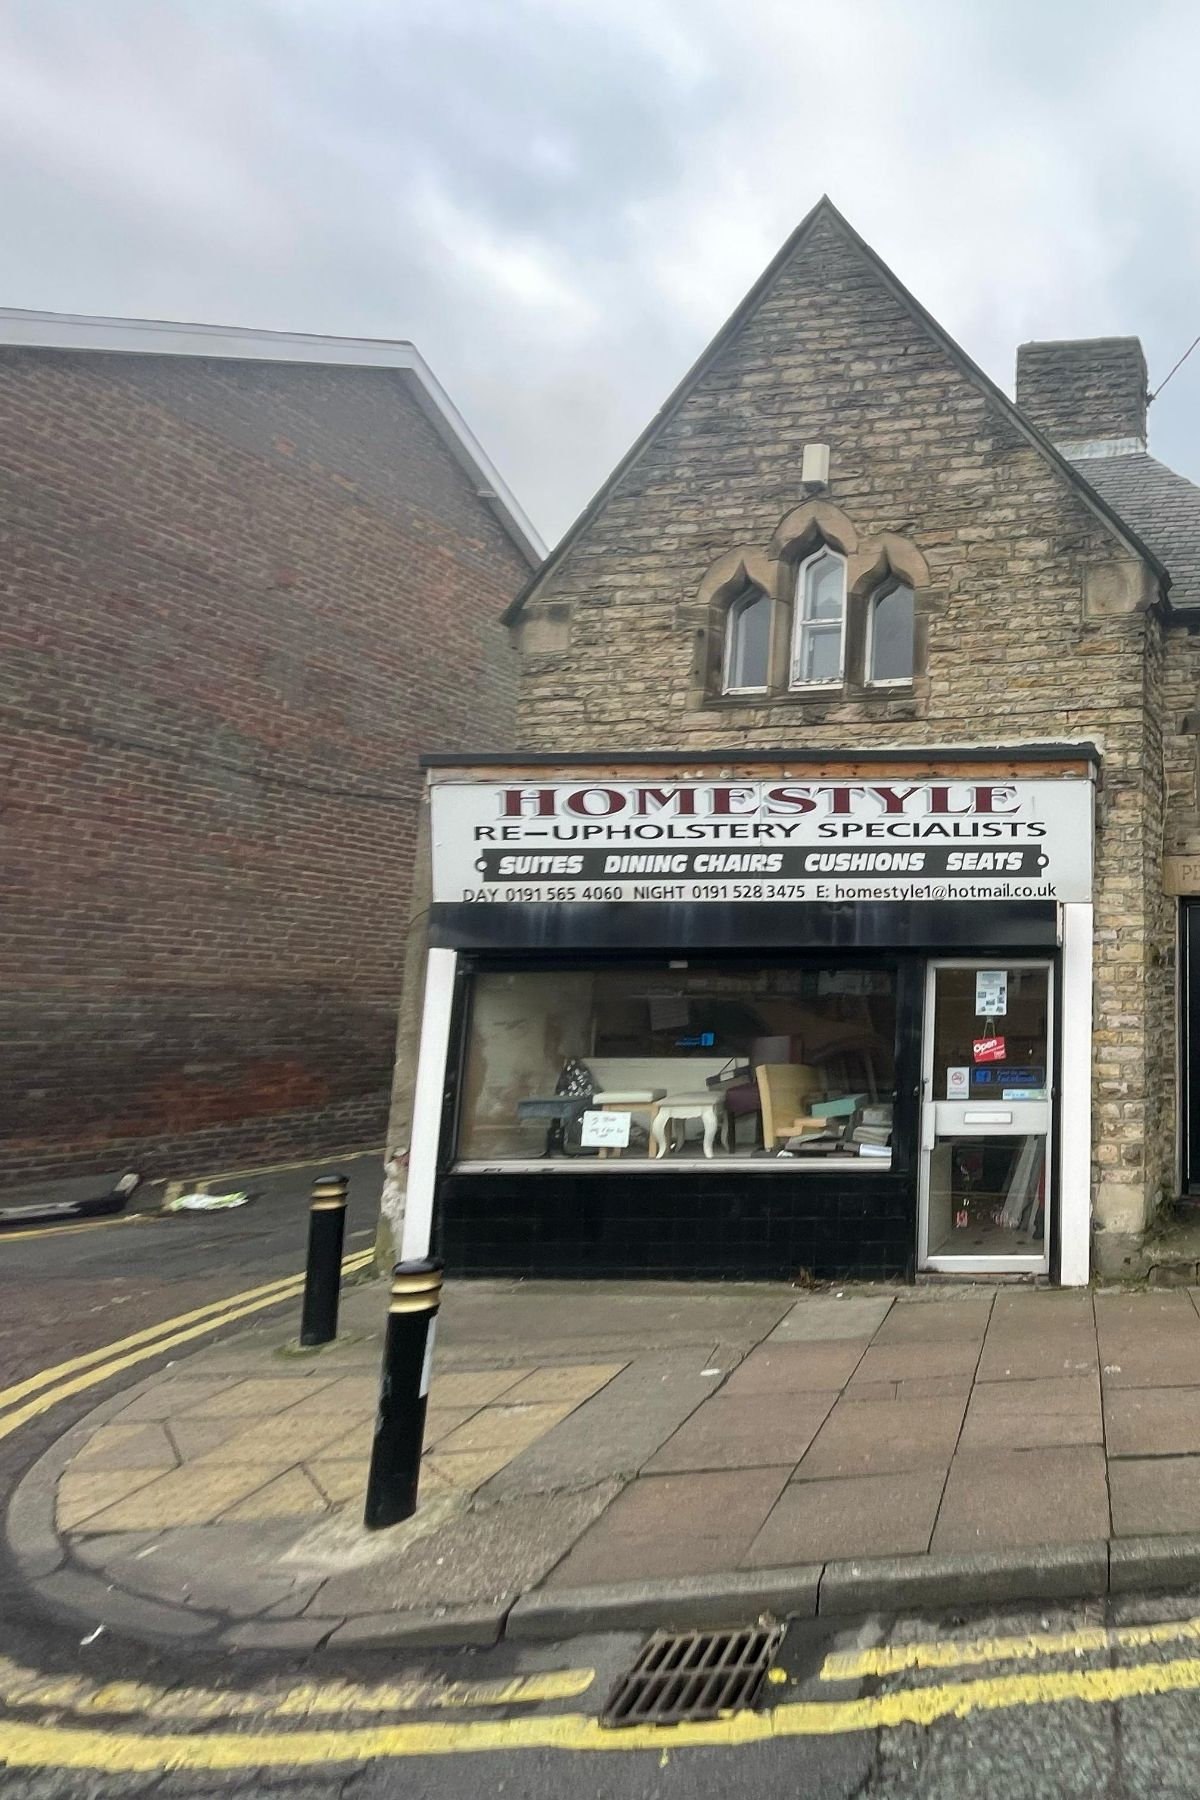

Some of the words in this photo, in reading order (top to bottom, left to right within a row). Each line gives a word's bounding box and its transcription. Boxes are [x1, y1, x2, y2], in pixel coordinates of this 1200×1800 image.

[499, 786, 1022, 819] HOMESTYLE
[474, 823, 801, 841] RE-UPHOLSTERY
[818, 822, 1047, 838] SPECIALISTS
[498, 855, 584, 874] SUITES
[604, 854, 689, 874] DINING
[693, 853, 784, 873] CHAIRS
[804, 853, 925, 872] CUSHIONS
[946, 852, 1023, 871] SEATS
[463, 888, 499, 902] DAY
[505, 887, 541, 901] 0191
[547, 887, 576, 900] 565
[582, 886, 623, 900] 4060
[634, 886, 686, 900] NIGHT
[692, 885, 728, 899] 0191
[733, 885, 762, 899] 528
[767, 885, 805, 898] 3475
[816, 885, 829, 897] E:
[835, 883, 1057, 900] homestyle1@hotmail.co.uk
[974, 1039, 998, 1053] Open
